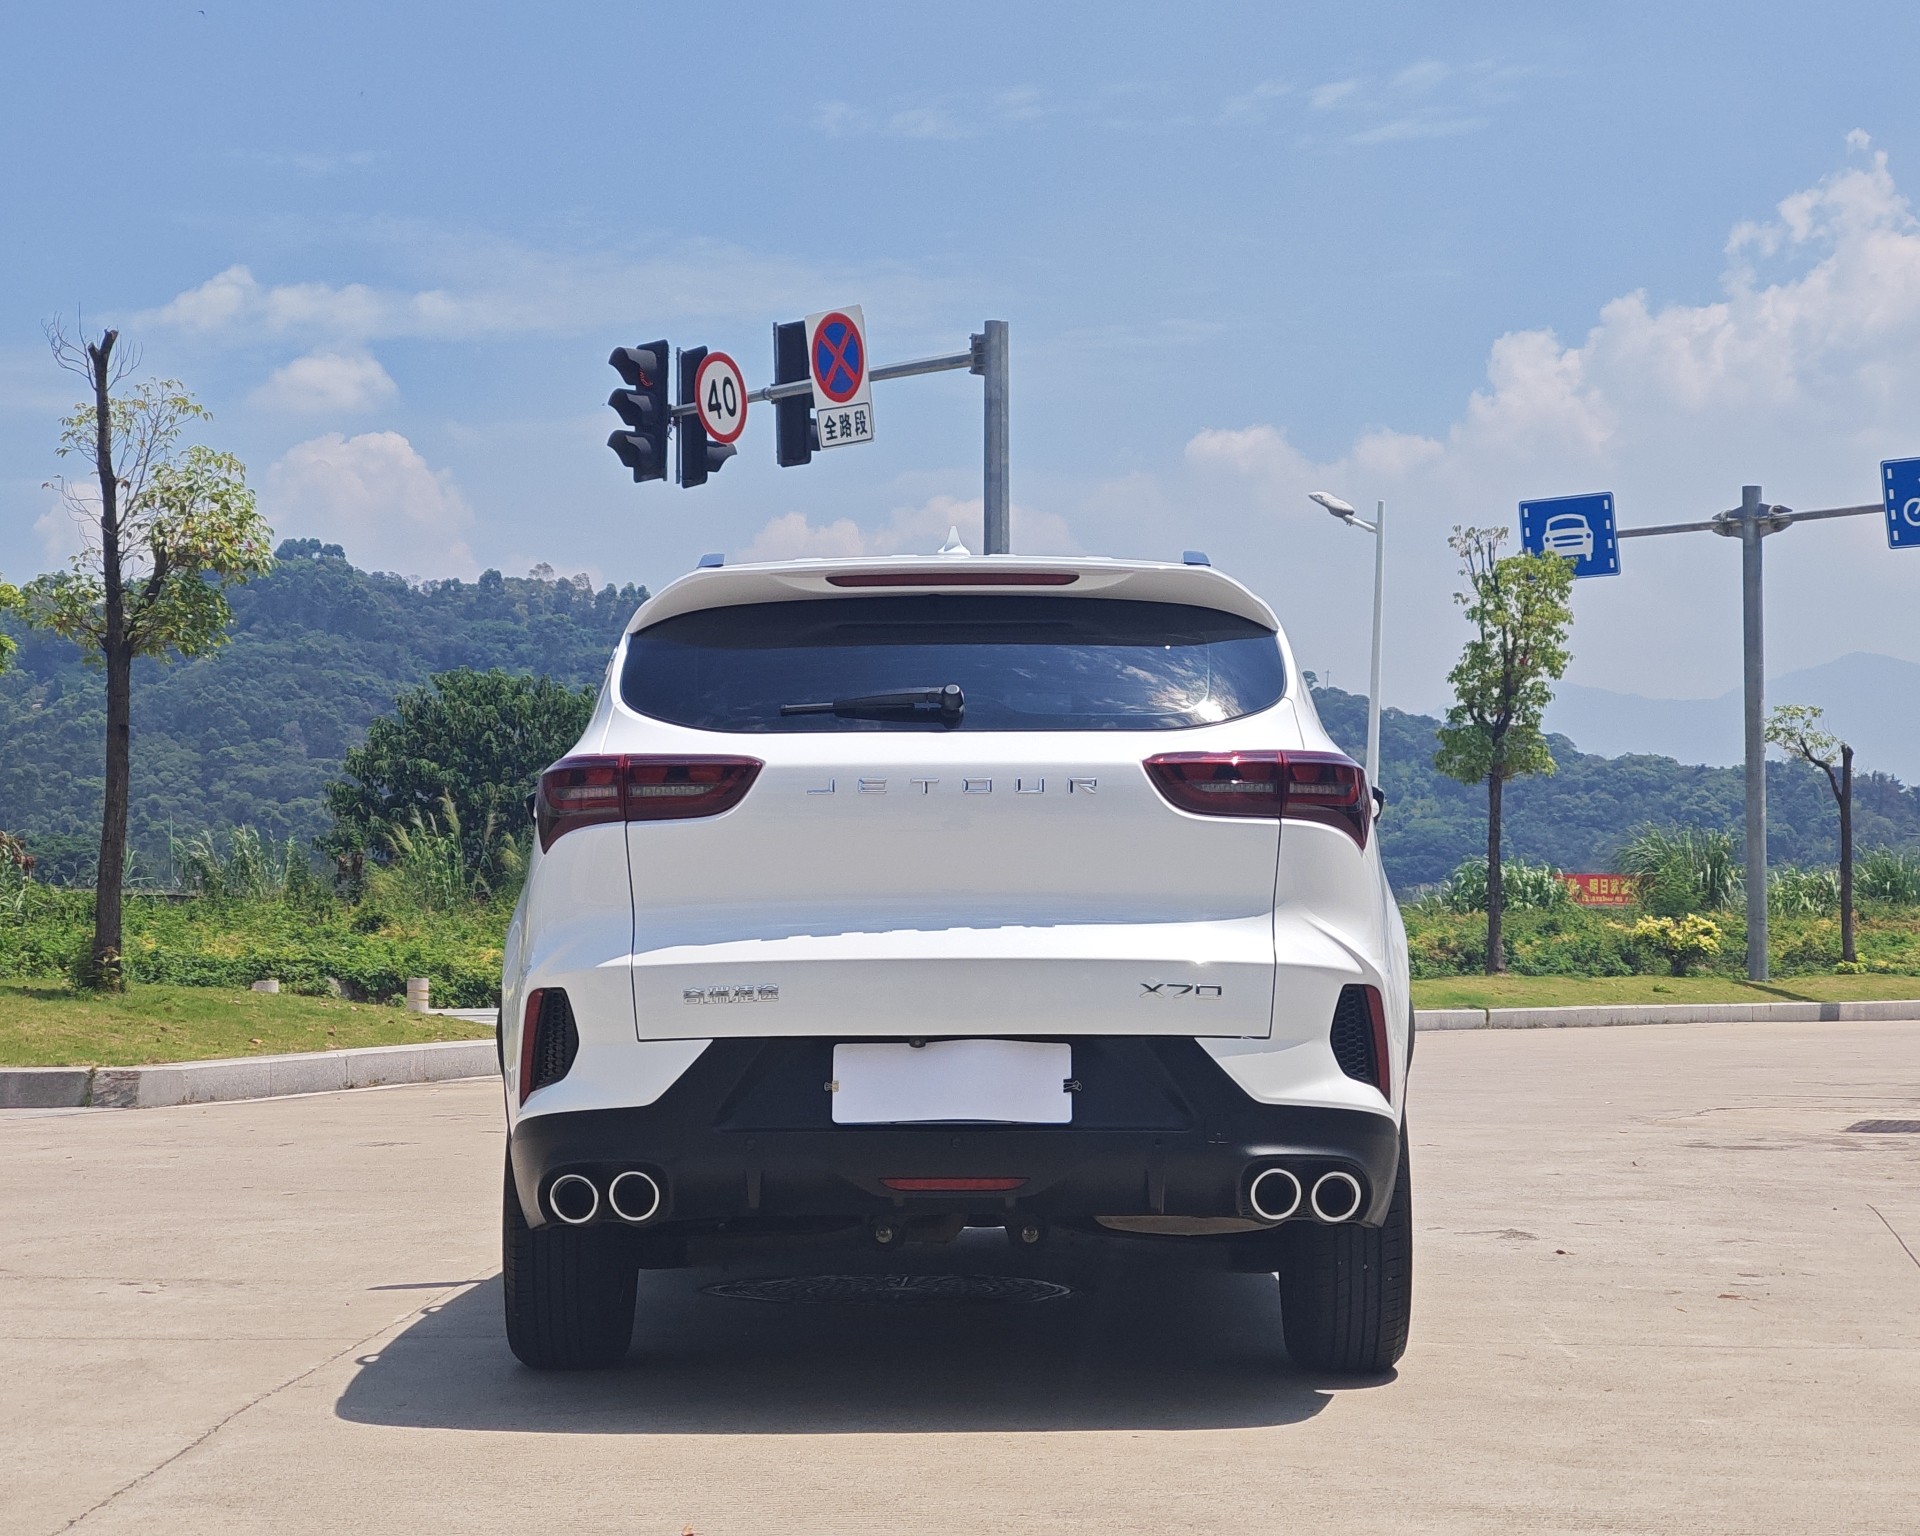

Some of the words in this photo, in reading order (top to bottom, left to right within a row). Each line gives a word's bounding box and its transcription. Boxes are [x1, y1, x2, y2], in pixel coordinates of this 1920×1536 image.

[708, 376, 737, 419] 40
[824, 410, 868, 441] 全路段
[807, 777, 1097, 794] JETOUR
[683, 983, 779, 1004] 奇瑞捷途
[1139, 983, 1222, 1000] X70
